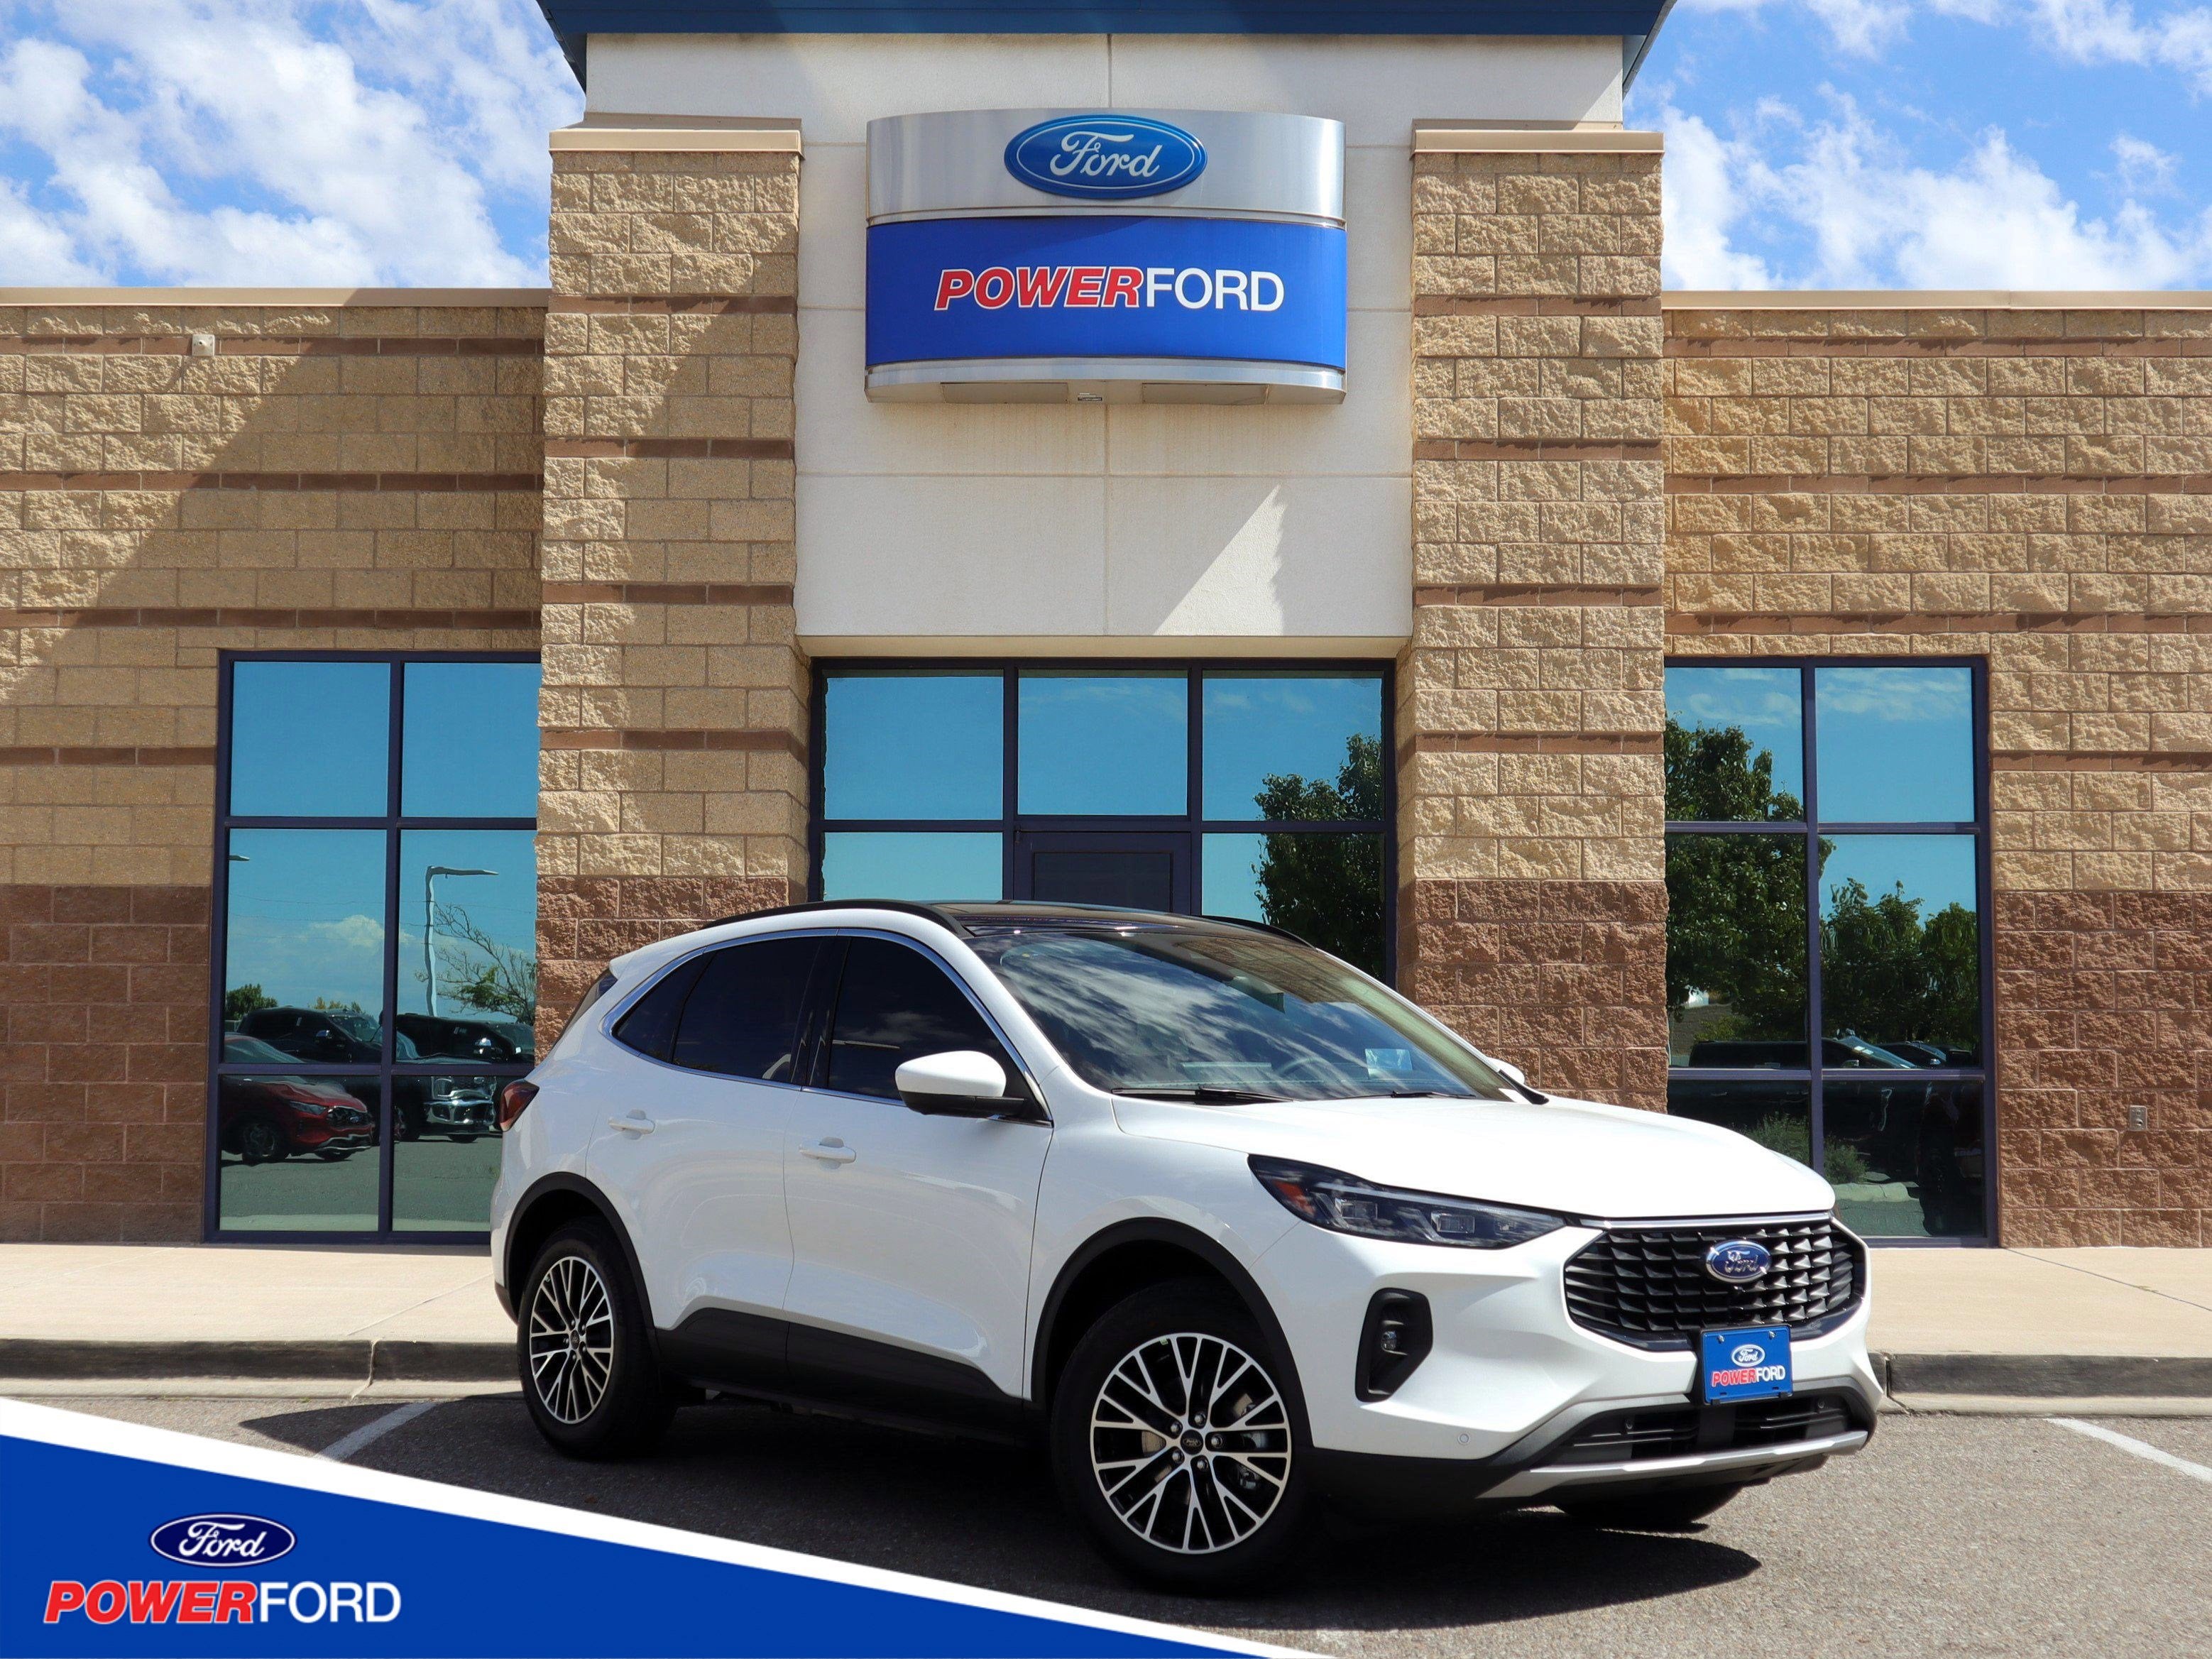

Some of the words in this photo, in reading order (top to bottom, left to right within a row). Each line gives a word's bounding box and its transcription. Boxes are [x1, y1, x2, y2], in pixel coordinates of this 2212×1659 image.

[1049, 131, 1162, 178] Ford
[1724, 1250, 1761, 1273] Ford
[1739, 1349, 1758, 1363] Ford
